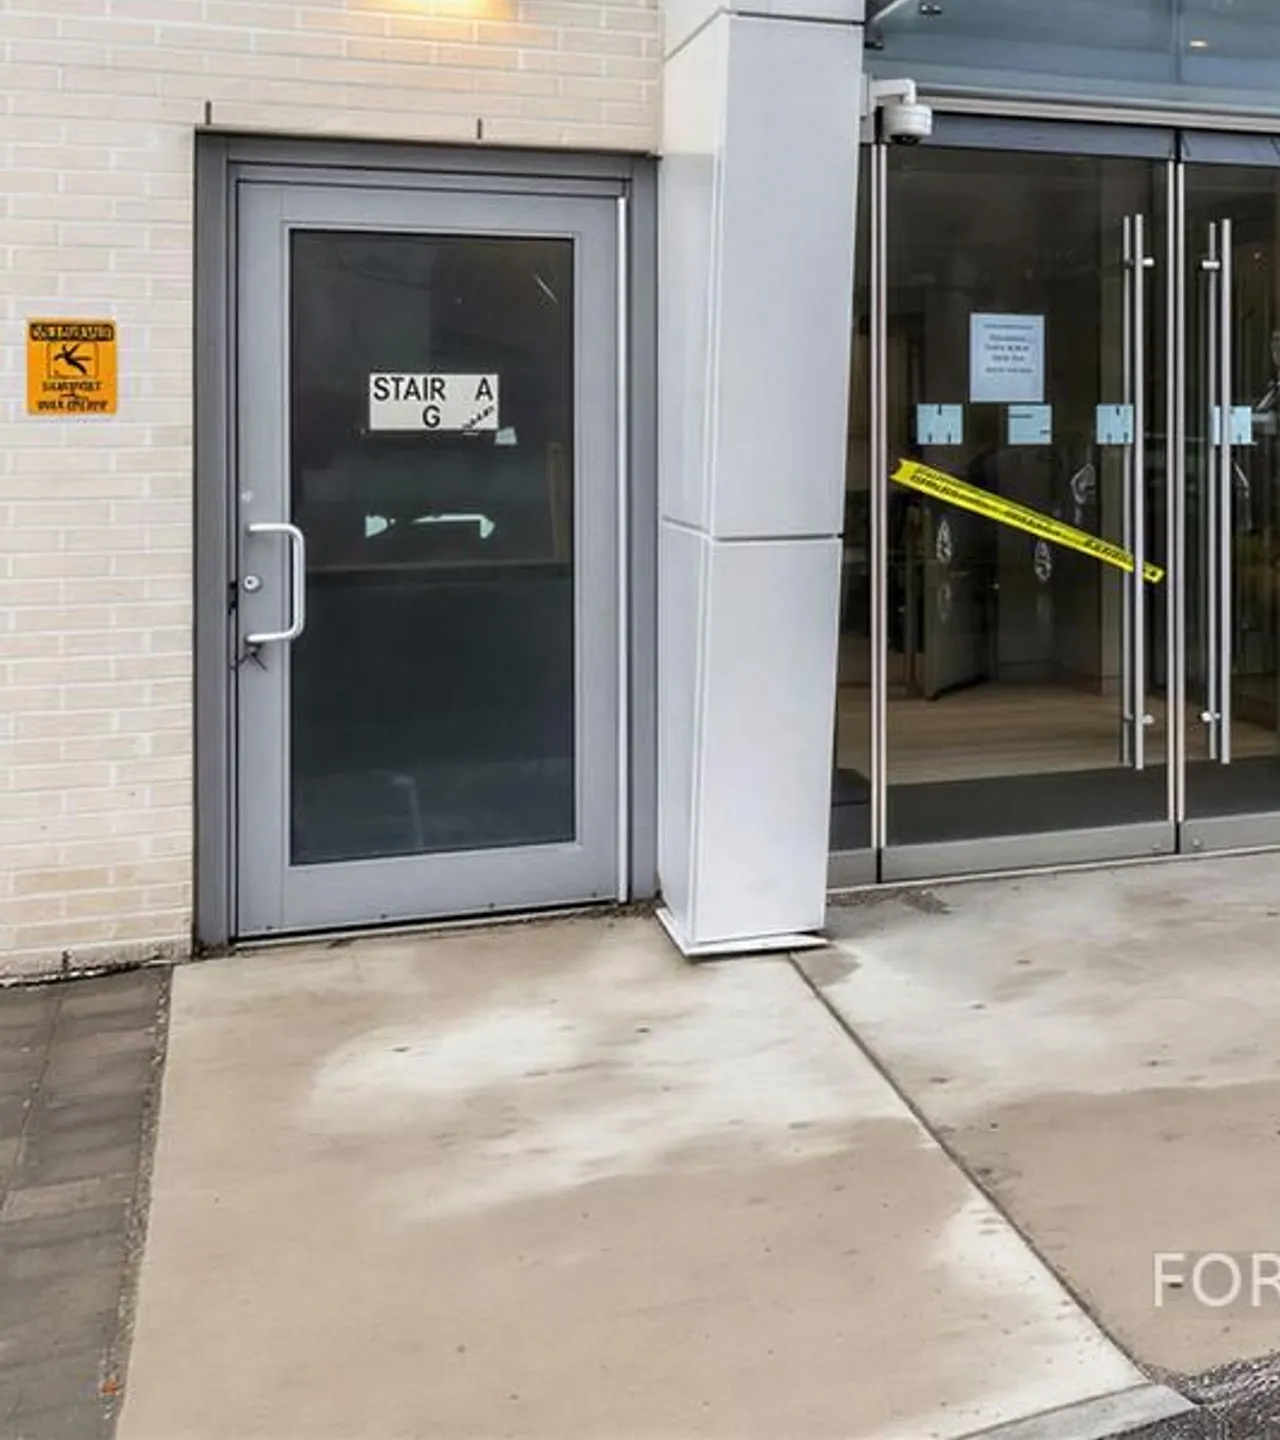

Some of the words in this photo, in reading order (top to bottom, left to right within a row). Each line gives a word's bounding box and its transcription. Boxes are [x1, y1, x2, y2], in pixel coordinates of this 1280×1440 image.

[373, 375, 446, 401] STAIR
[474, 376, 494, 401] A
[422, 404, 442, 429] G
